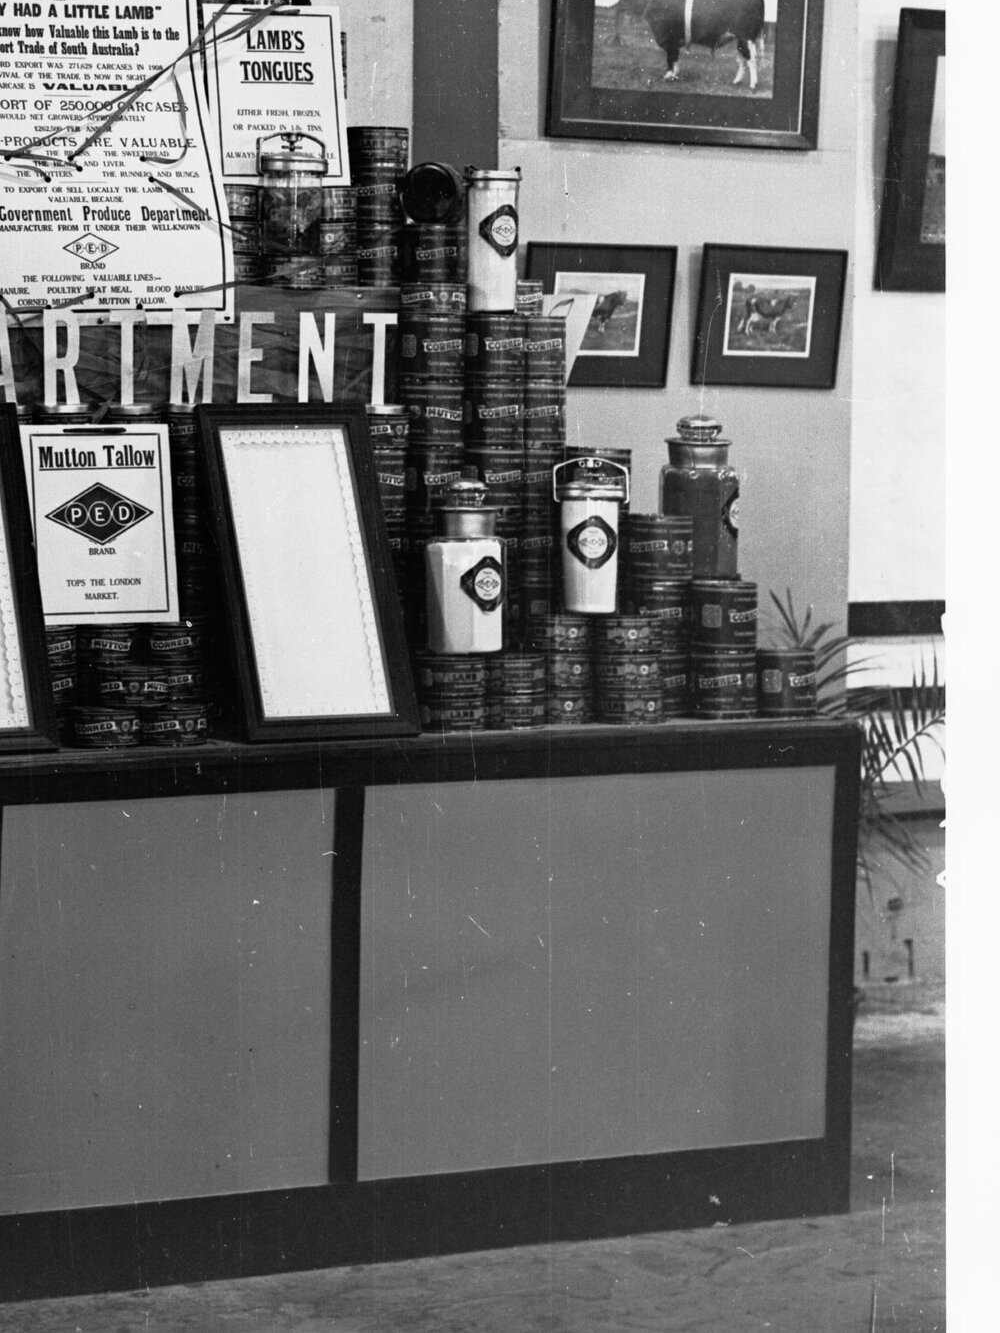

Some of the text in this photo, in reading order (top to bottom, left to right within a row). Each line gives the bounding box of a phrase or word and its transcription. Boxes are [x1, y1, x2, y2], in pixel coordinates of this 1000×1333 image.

[13, 3, 42, 18] HAD
[48, 4, 58, 18] A
[64, 4, 110, 19] LITTLE
[25, 24, 44, 38] how
[49, 24, 89, 39] Valuable
[92, 26, 110, 39] this
[113, 26, 138, 40] Lamb
[141, 27, 150, 40] is
[153, 28, 162, 40] to
[165, 27, 180, 41] the
[246, 29, 305, 51] LAMB'S
[18, 40, 45, 54] Trade
[49, 42, 58, 55] of
[61, 42, 88, 55] South
[92, 43, 140, 56] Australia?
[15, 61, 43, 69] EXPORT
[96, 63, 133, 71] CARCASES
[239, 60, 314, 82] TONGUES
[33, 100, 53, 111] OF
[119, 137, 198, 148] VALUABLE
[226, 151, 256, 159] ALWAYS
[16, 170, 31, 178] THE
[357, 183, 396, 196] CORNED
[82, 205, 131, 222] Produce
[140, 205, 211, 223] Department
[57, 224, 79, 232] FROM
[83, 224, 91, 232] IT
[95, 224, 123, 232] UNDER
[125, 224, 146, 232] THEIR
[359, 246, 398, 260] CORNED
[416, 246, 457, 260] CORNED
[80, 262, 106, 270] BRAND
[41, 274, 85, 282] FOLLOWING
[93, 274, 132, 282] VALUABLE
[47, 286, 82, 294] POULTRY
[147, 285, 171, 293] BLOOD
[18, 298, 49, 306] CORNED
[99, 297, 130, 305] MUTTON
[424, 339, 463, 352] CORNED
[485, 338, 524, 351] CORNED
[525, 338, 563, 352] CORNED
[479, 405, 519, 419] CORNED
[38, 445, 155, 469] Mutton Tallow
[88, 547, 117, 556] BRAND.
[66, 577, 141, 587] TOPS THE LONDON
[85, 592, 119, 600] MARKET.
[92, 639, 132, 651] MUTTON
[150, 637, 192, 650] CORNED
